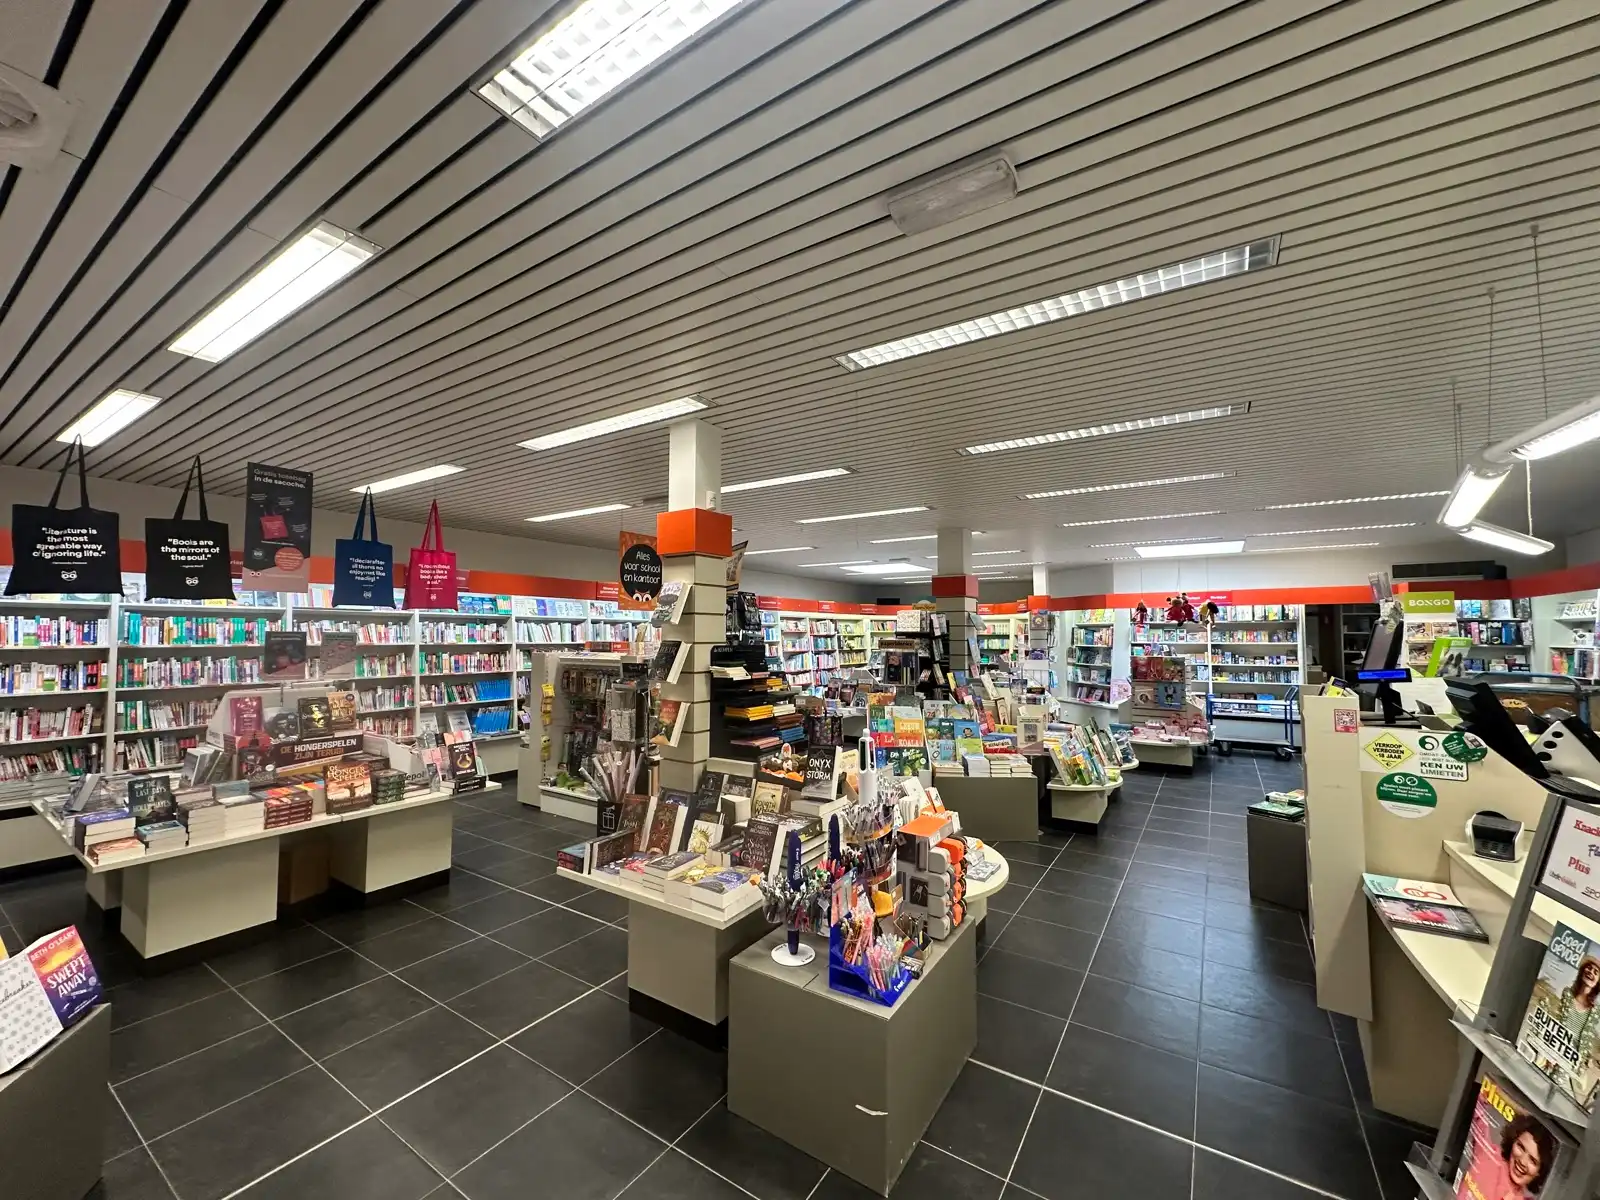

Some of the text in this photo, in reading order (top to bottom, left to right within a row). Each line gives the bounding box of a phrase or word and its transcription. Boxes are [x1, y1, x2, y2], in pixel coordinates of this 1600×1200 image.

[636, 551, 651, 561] Alles
[624, 562, 660, 573] voor school
[634, 572, 660, 584] kantoor
[1409, 598, 1450, 607] BONGO
[280, 738, 357, 754] DE HONGERSPELEN
[294, 751, 314, 760] ZIJN
[809, 758, 831, 769] ONYX
[806, 770, 831, 781] STORM
[1420, 769, 1464, 778] LIMIETEN
[136, 786, 166, 797] LAST DAYS
[1568, 856, 1591, 875] Plus
[1585, 886, 1600, 898] SPO
[31, 930, 76, 961] BETH O'LEARY
[1561, 930, 1588, 954] Goed
[1550, 936, 1584, 968] Gevoel
[46, 954, 86, 989] SWEPT
[57, 969, 87, 998] AWAY
[1535, 1007, 1573, 1045] BUITEN
[1533, 1019, 1545, 1032] HET
[1543, 1030, 1579, 1066] BETER
[1480, 1077, 1516, 1122] Plus
